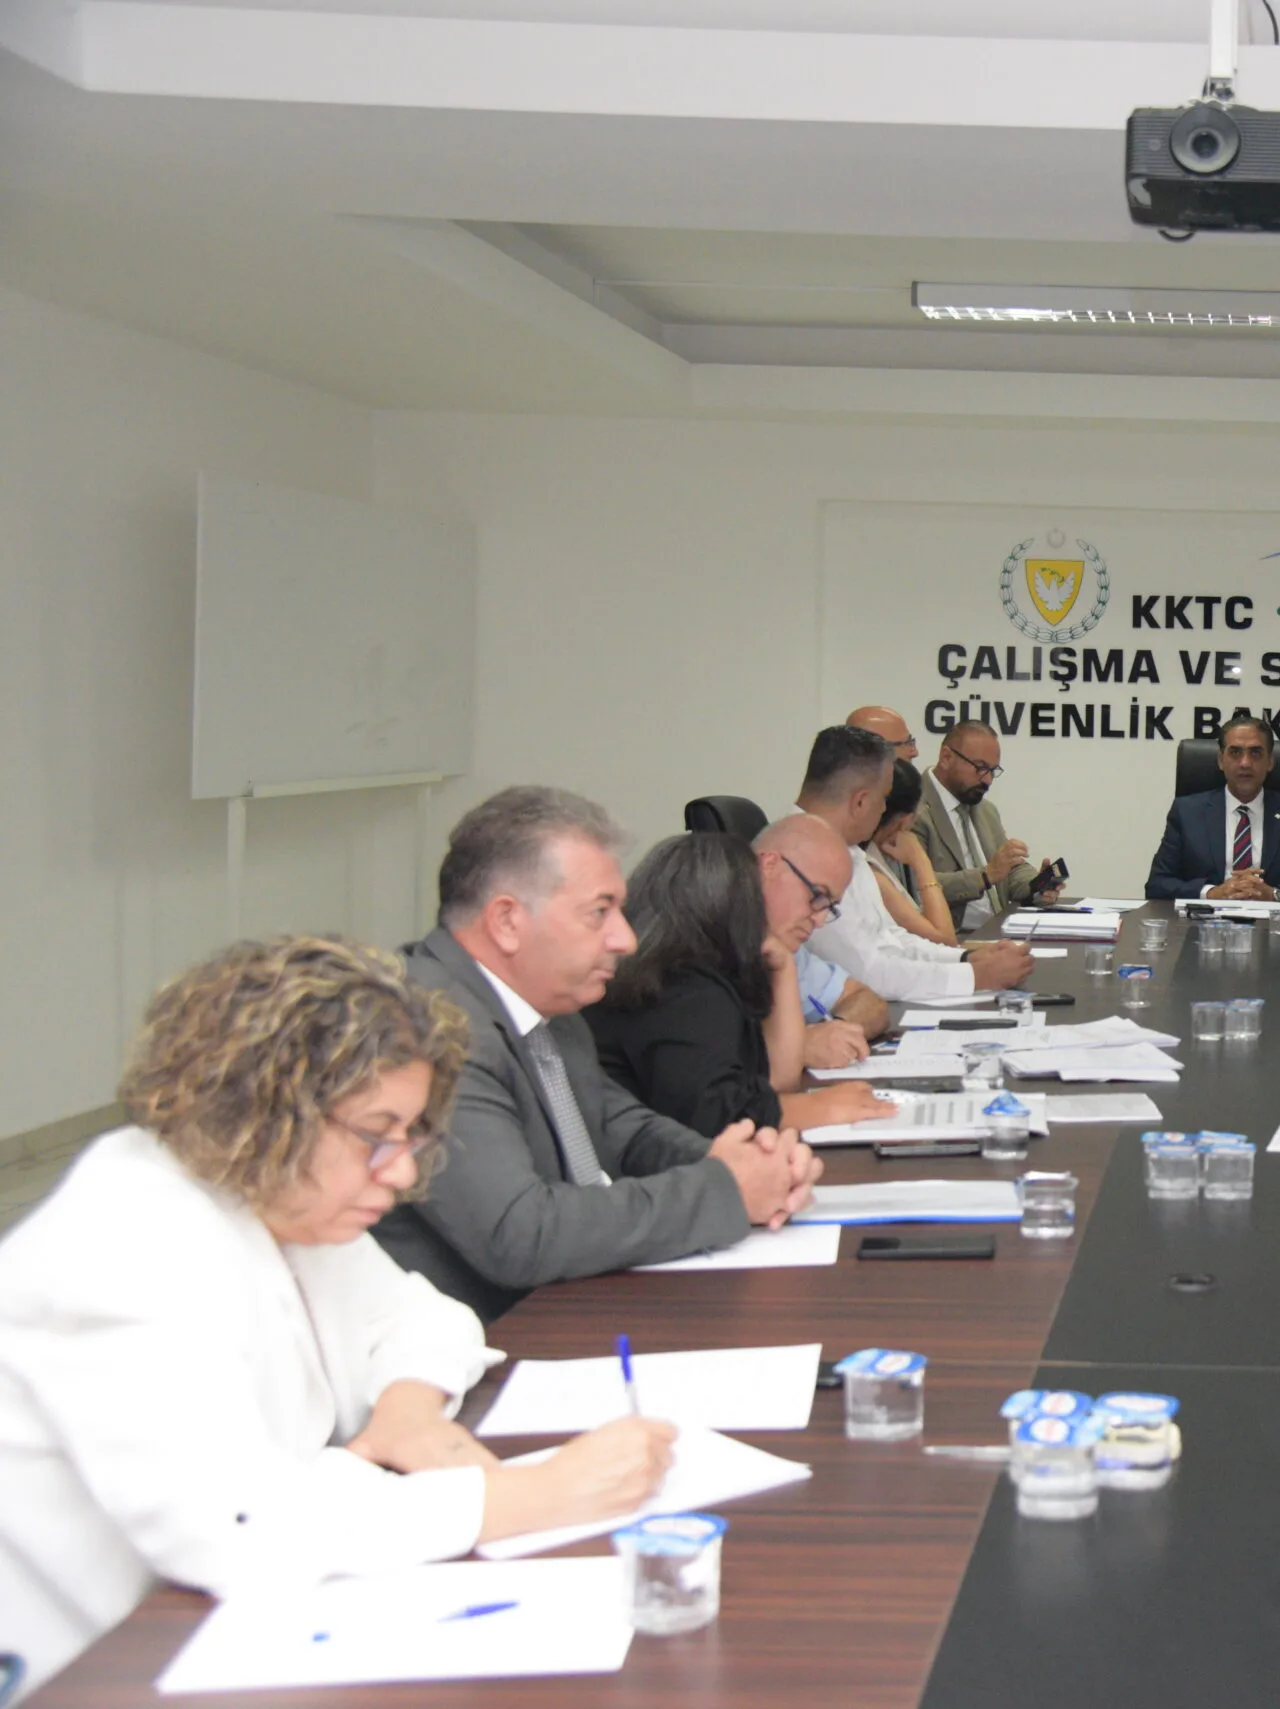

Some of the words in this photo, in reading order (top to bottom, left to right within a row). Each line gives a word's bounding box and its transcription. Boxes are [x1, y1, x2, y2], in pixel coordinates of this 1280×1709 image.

[1132, 595, 1254, 630] KKTC
[938, 644, 1160, 692] ÇALIŞMA
[1179, 650, 1241, 685] VE
[924, 694, 1175, 740] GÜVENLİK
